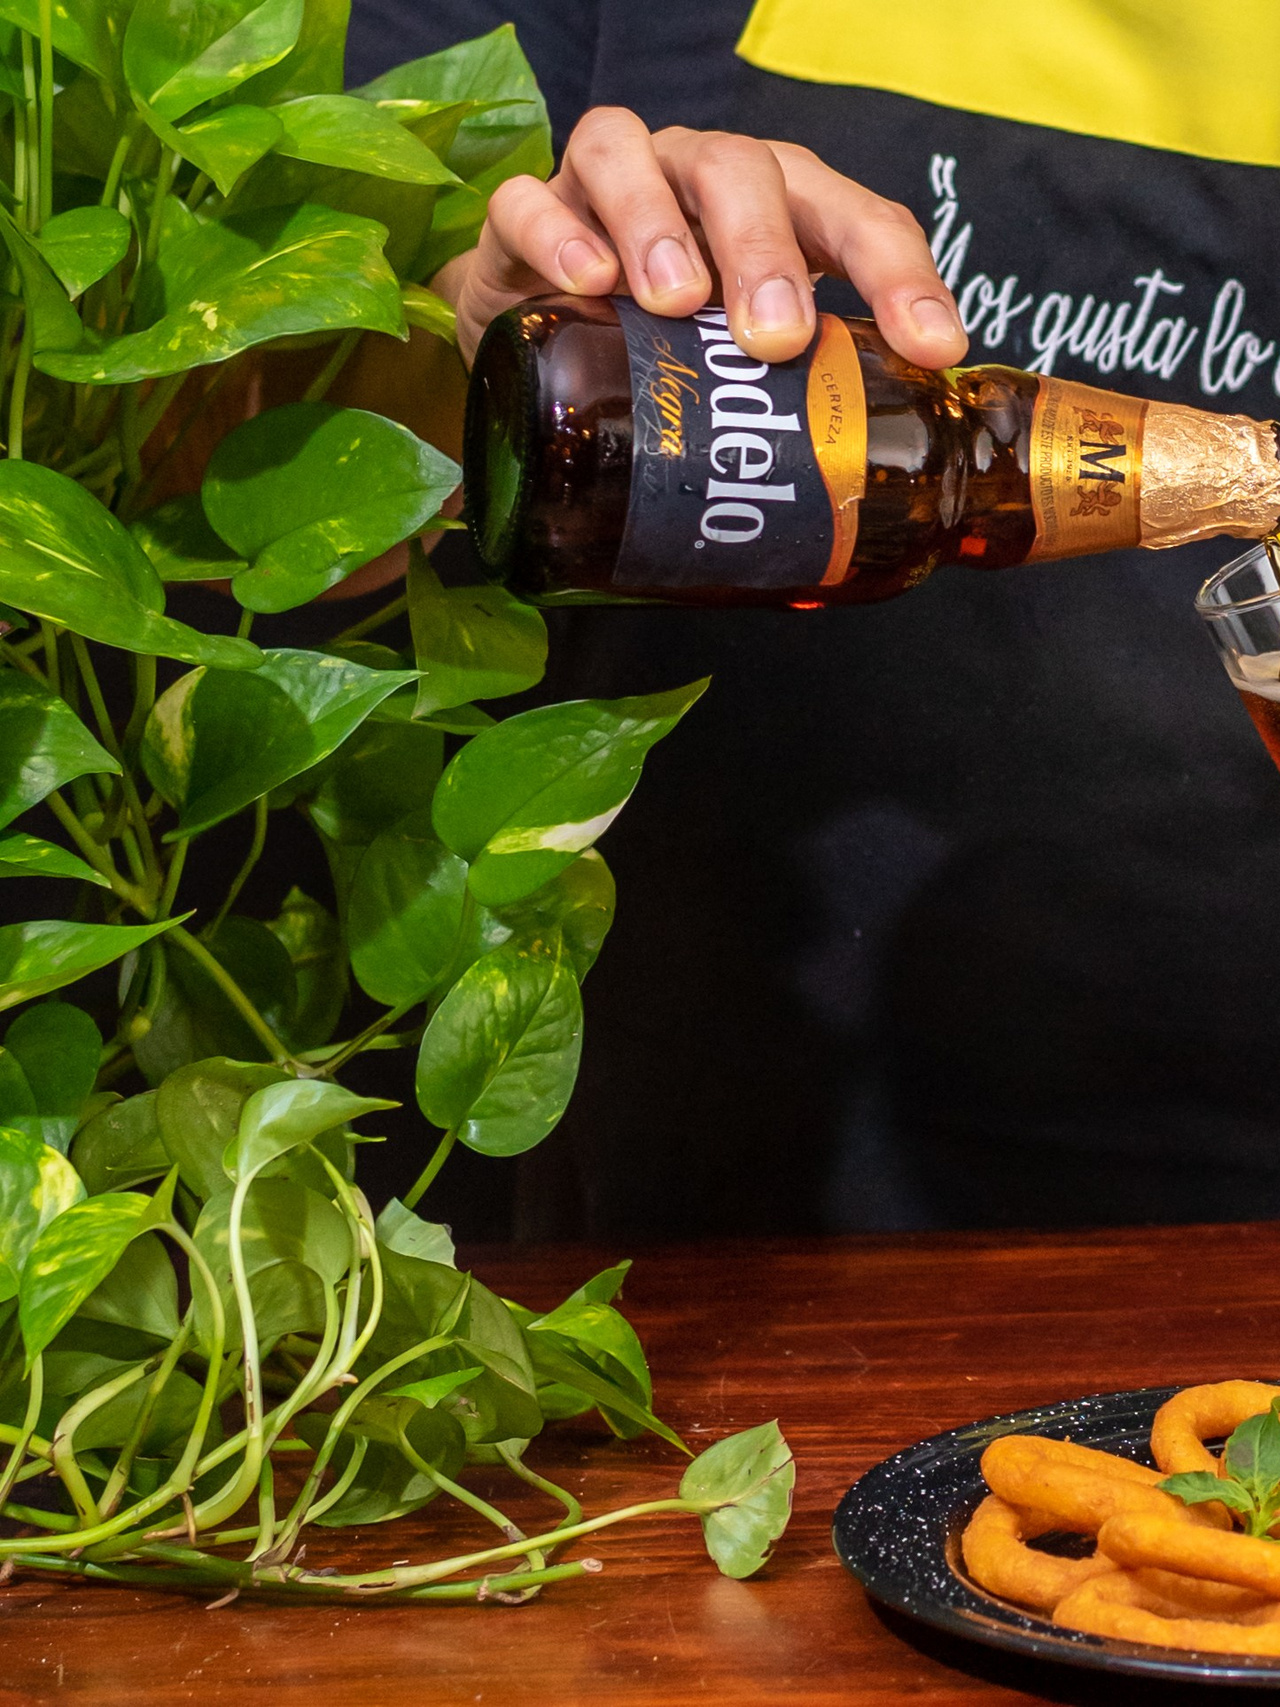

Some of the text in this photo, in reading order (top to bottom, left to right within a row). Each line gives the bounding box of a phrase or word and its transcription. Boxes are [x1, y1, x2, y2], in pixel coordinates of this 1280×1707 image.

[1023, 268, 1200, 380] gusta
[1203, 279, 1272, 396] lo
[649, 336, 700, 458] Negra
[693, 307, 801, 543] odelo
[821, 372, 843, 445] CERVEZA
[1039, 451, 1054, 495] PRODUCTO
[1079, 440, 1127, 484] M
